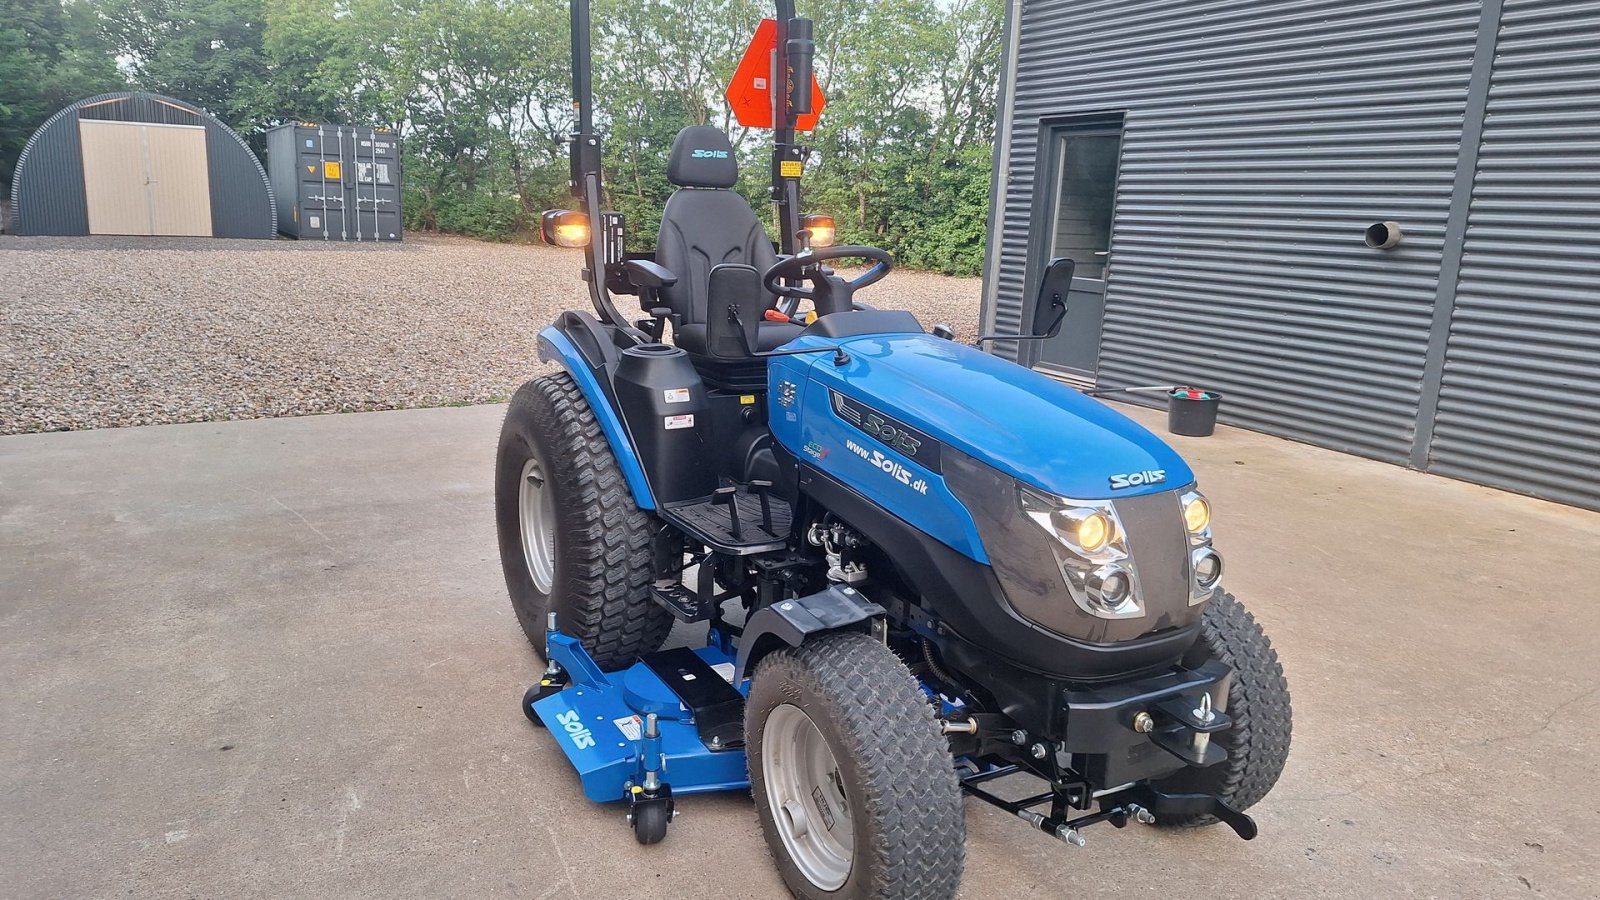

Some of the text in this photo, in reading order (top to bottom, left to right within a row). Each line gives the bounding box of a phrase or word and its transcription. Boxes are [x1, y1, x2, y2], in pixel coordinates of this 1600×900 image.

[691, 149, 728, 159] Solis
[862, 413, 922, 456] Solis
[846, 439, 928, 496] www.Solis.dk
[556, 710, 595, 749] Solis
